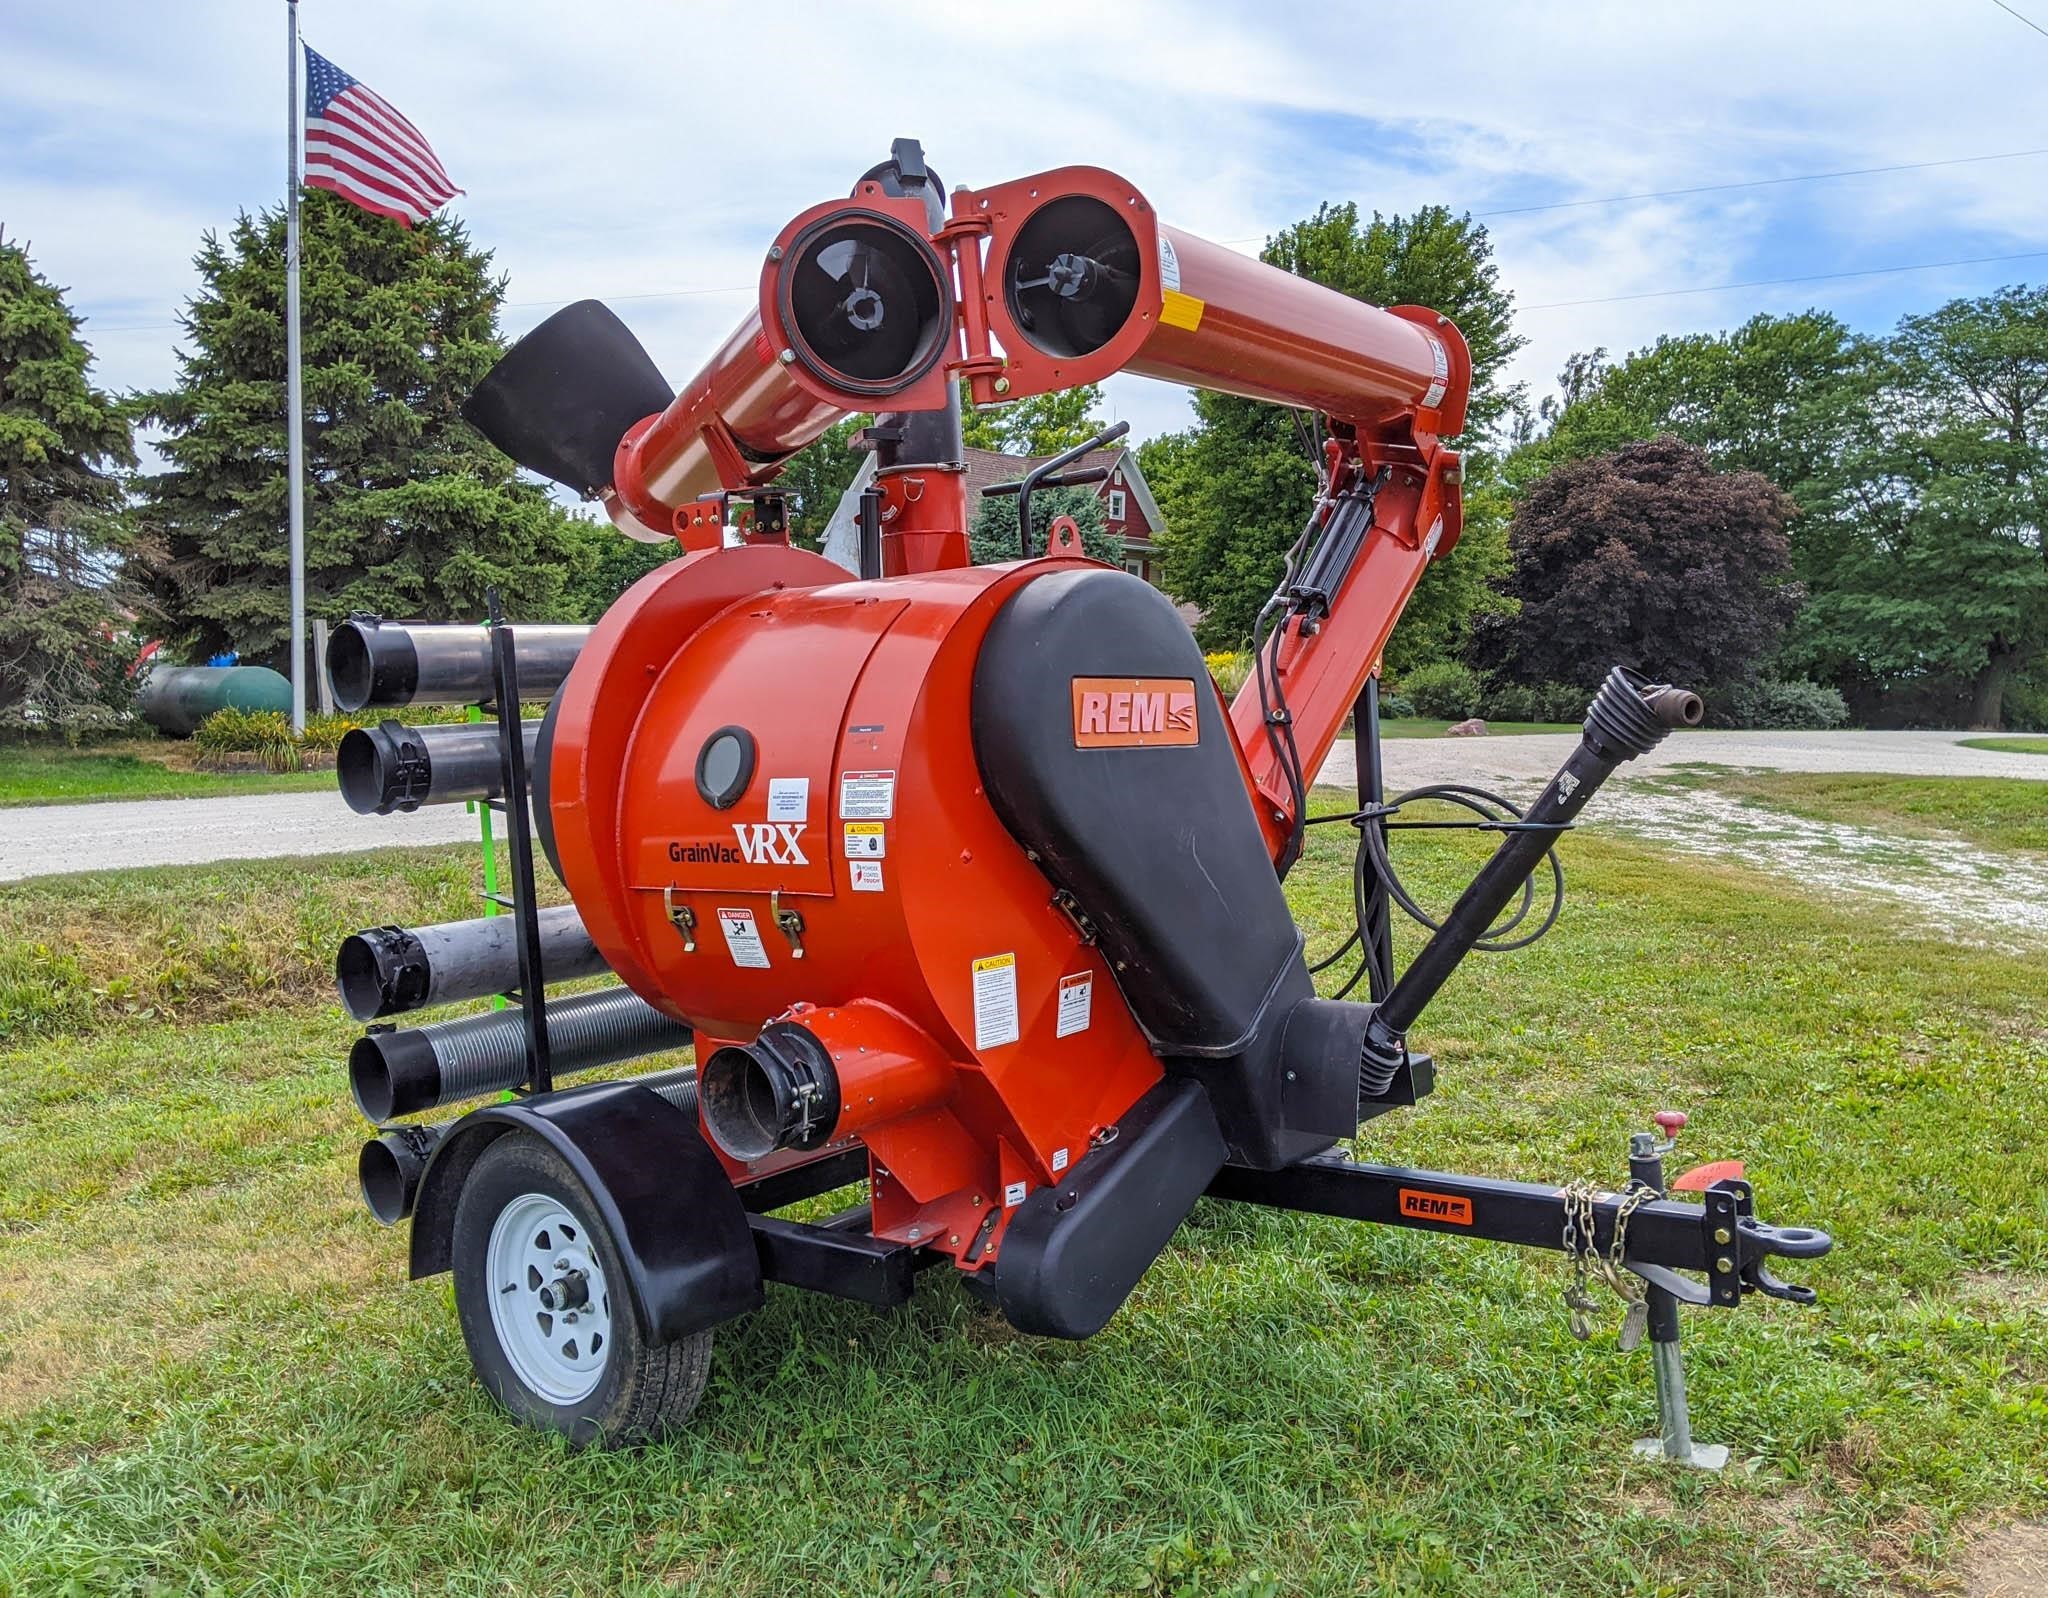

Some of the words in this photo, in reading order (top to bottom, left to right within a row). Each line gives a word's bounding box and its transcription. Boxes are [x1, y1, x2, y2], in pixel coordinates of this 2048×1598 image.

[1080, 692, 1165, 734] REM
[669, 842, 740, 863] GrainVac
[732, 824, 809, 864] VRX
[727, 911, 751, 919] DANGER
[984, 958, 1011, 969] CAUTION
[1405, 1195, 1449, 1216] REM
